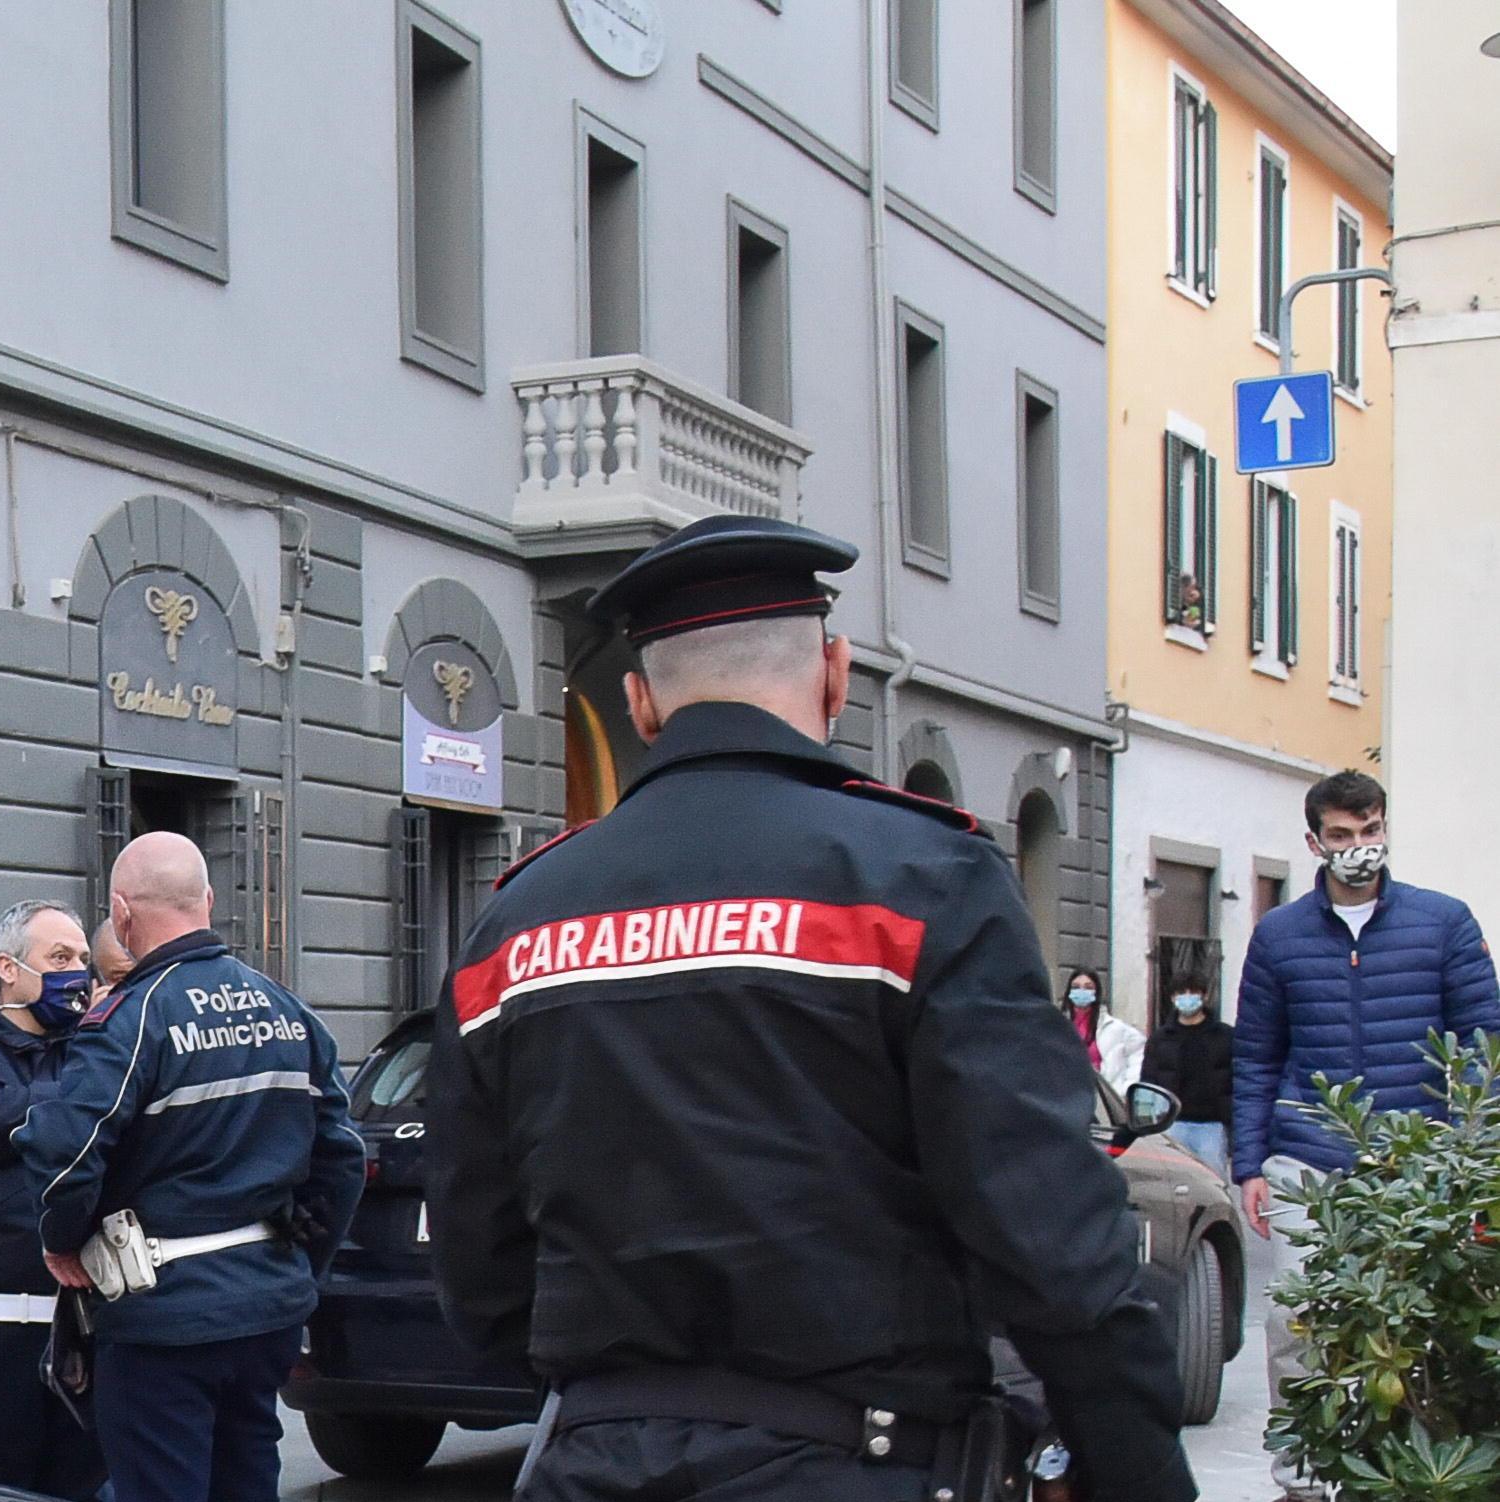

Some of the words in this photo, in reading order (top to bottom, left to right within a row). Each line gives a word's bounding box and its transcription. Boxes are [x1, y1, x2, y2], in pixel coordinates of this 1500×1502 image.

[506, 902, 802, 984] CARABINIERI
[185, 983, 271, 1015] Polizia
[168, 1014, 307, 1055] Municipale
